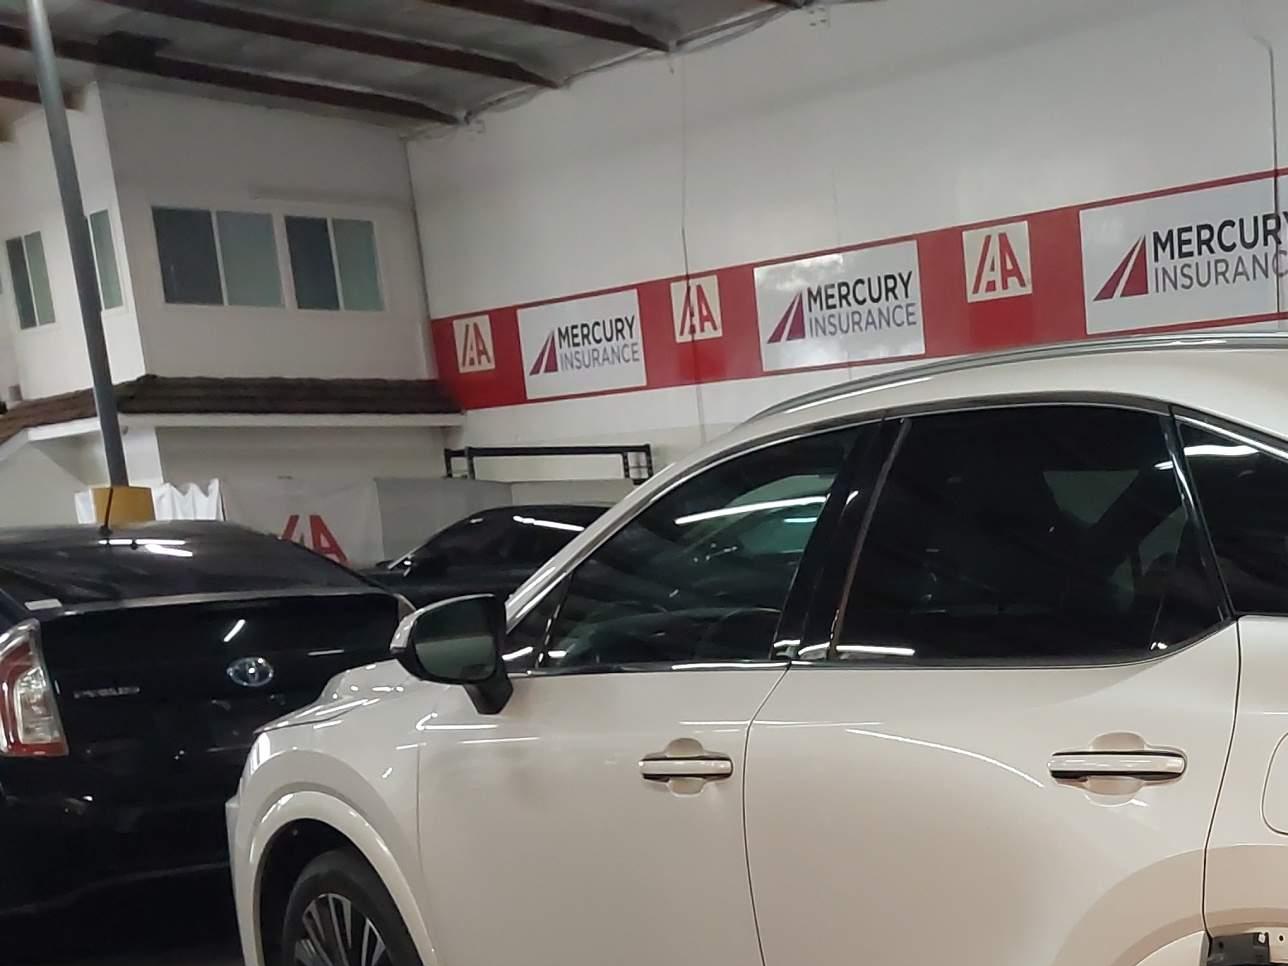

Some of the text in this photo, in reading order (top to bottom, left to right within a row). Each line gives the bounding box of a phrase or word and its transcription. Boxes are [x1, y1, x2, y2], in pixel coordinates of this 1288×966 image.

[807, 271, 912, 312] MERCURY
[557, 315, 635, 349] MERCURY
[809, 303, 916, 337] INSURANCE
[559, 343, 640, 370] INSURANCE
